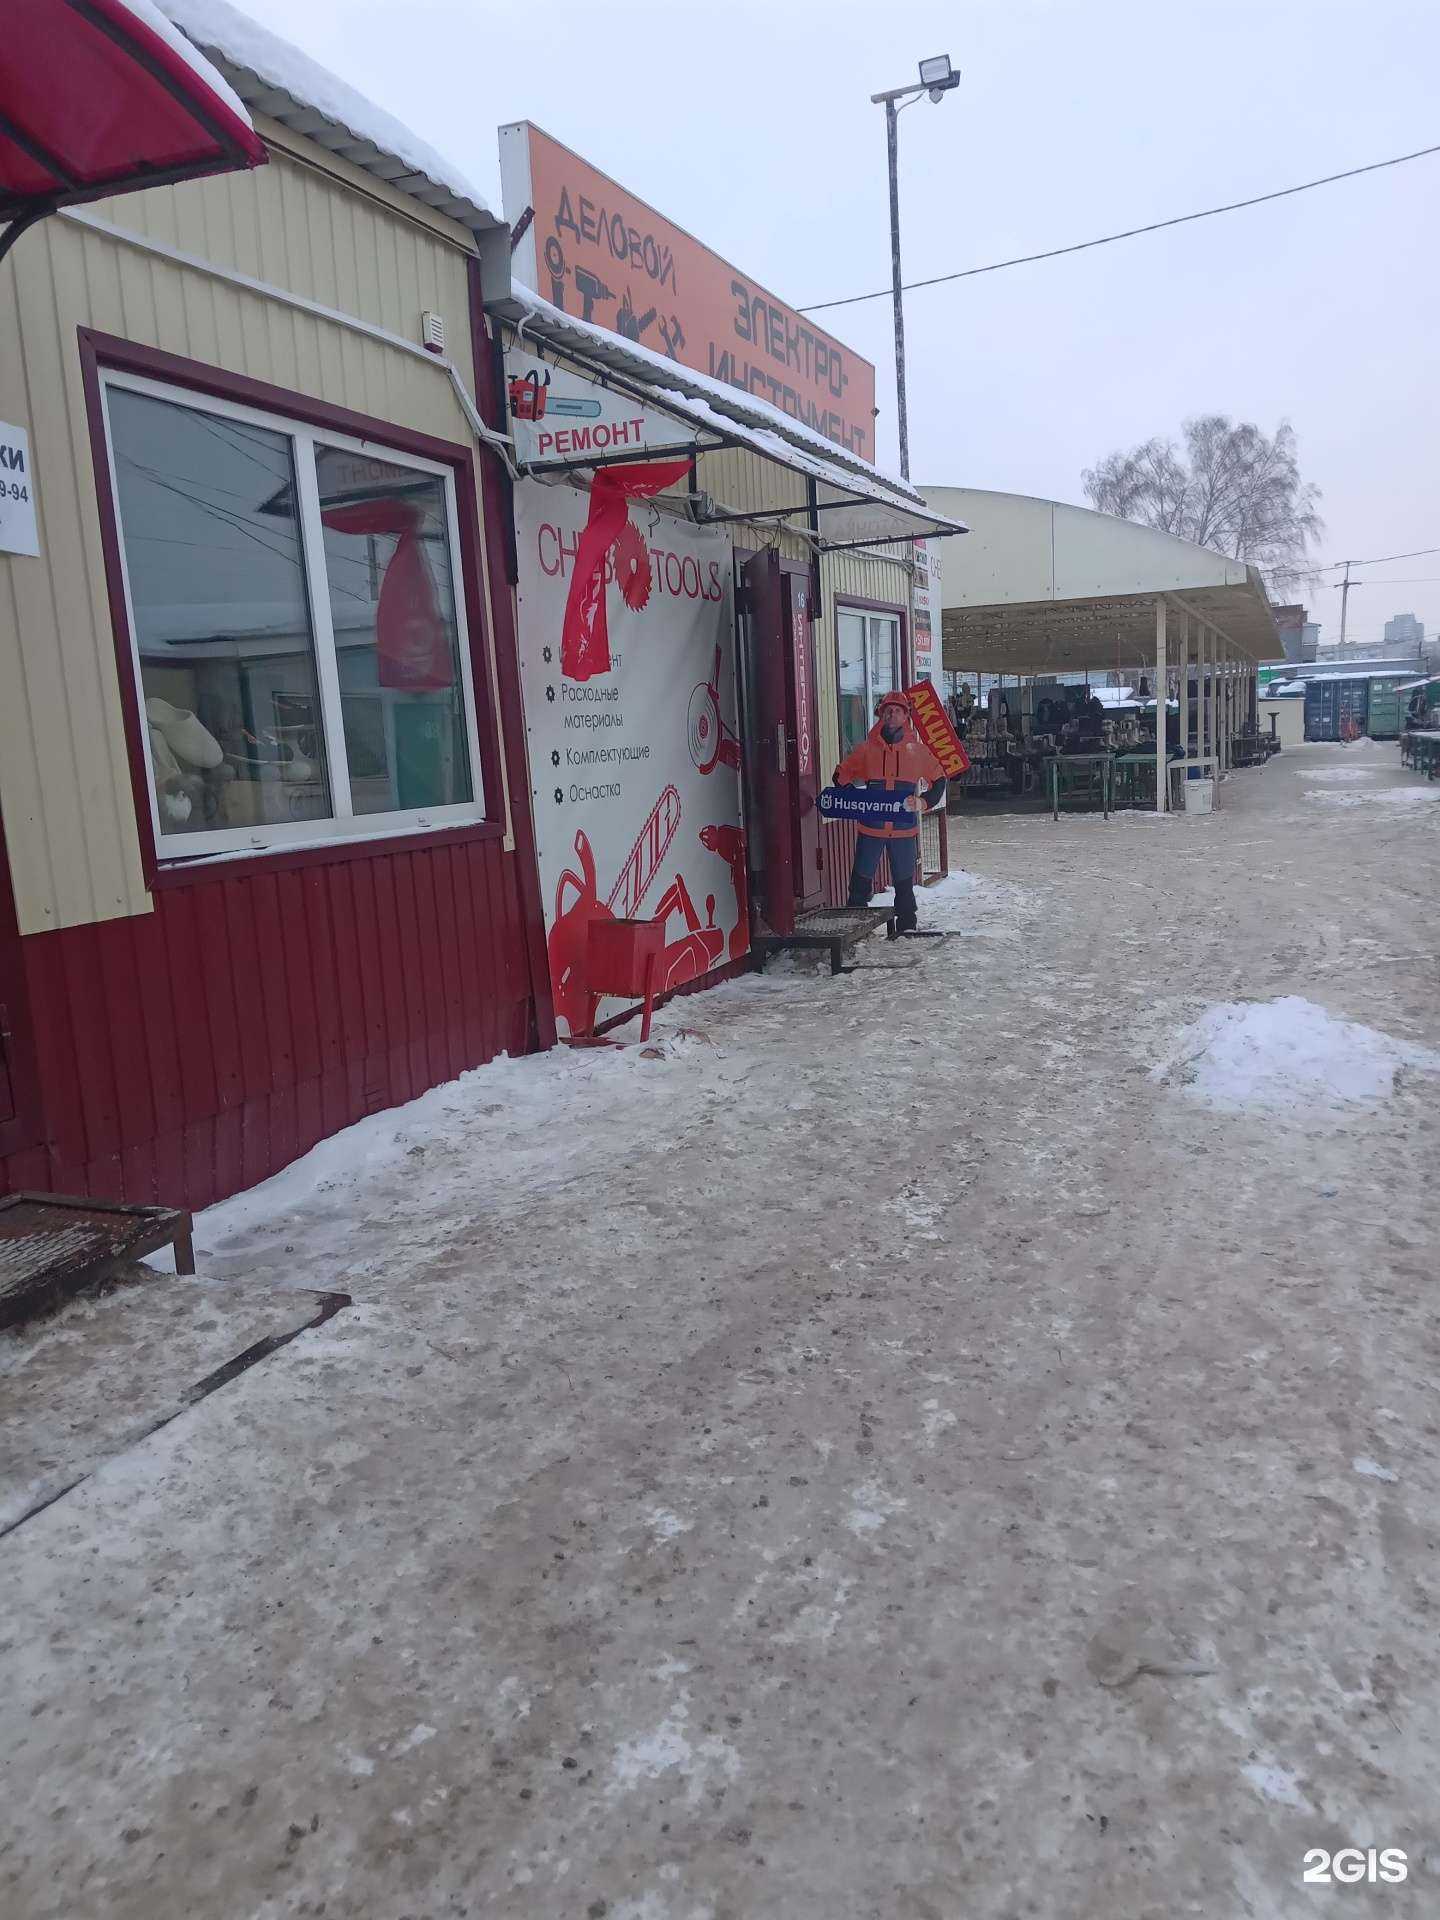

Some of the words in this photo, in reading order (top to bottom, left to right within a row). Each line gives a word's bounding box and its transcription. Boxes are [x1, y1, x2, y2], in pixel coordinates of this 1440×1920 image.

[555, 186, 677, 296] ДЕЛОВОЙ
[731, 280, 848, 398] ЭЛЕКТРО-
[538, 418, 645, 456] РЕМОНТ
[562, 684, 619, 702] Расходные
[564, 713, 624, 732] материалы
[907, 688, 966, 776] АКЦИЯ
[566, 745, 650, 766] Комплектующие
[569, 782, 621, 803] Оснастка
